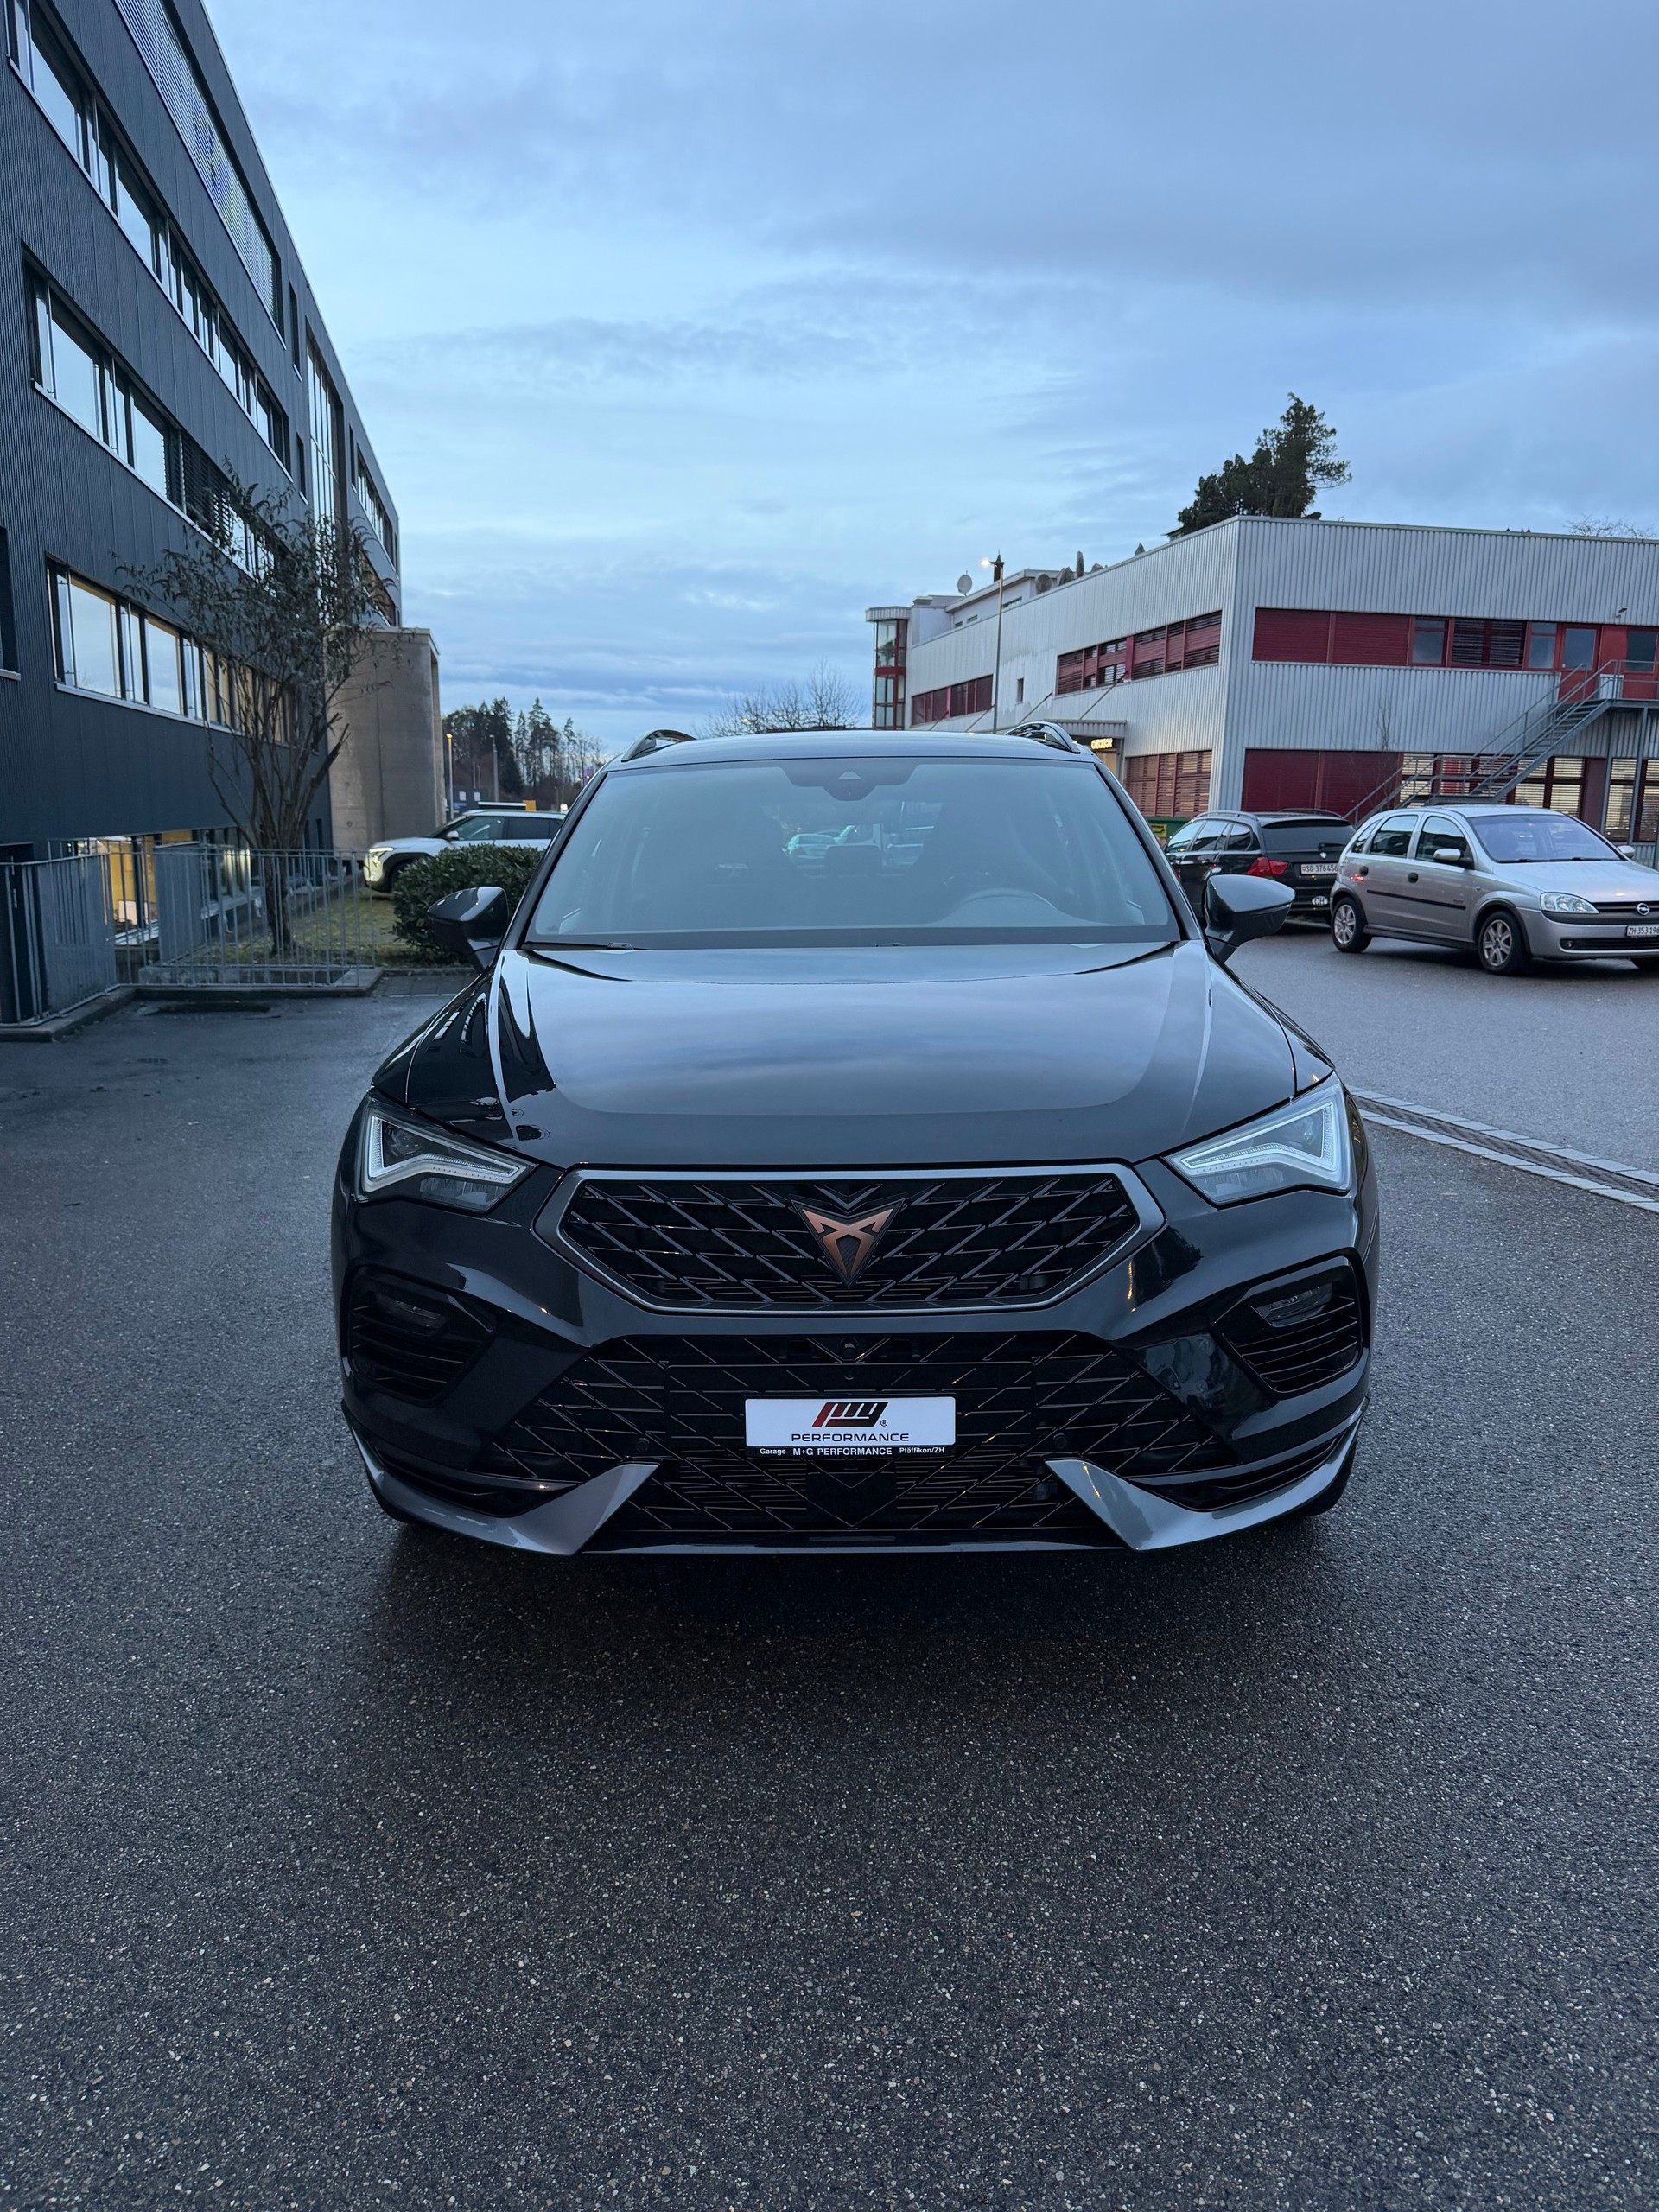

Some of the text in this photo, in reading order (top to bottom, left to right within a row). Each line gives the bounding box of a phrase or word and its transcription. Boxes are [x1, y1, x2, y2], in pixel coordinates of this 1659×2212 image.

[791, 1433, 909, 1442] PERFORMANCE
[760, 1447, 786, 1456] Garage
[792, 1447, 814, 1456] M+G
[817, 1447, 893, 1456] PERFORMANCE
